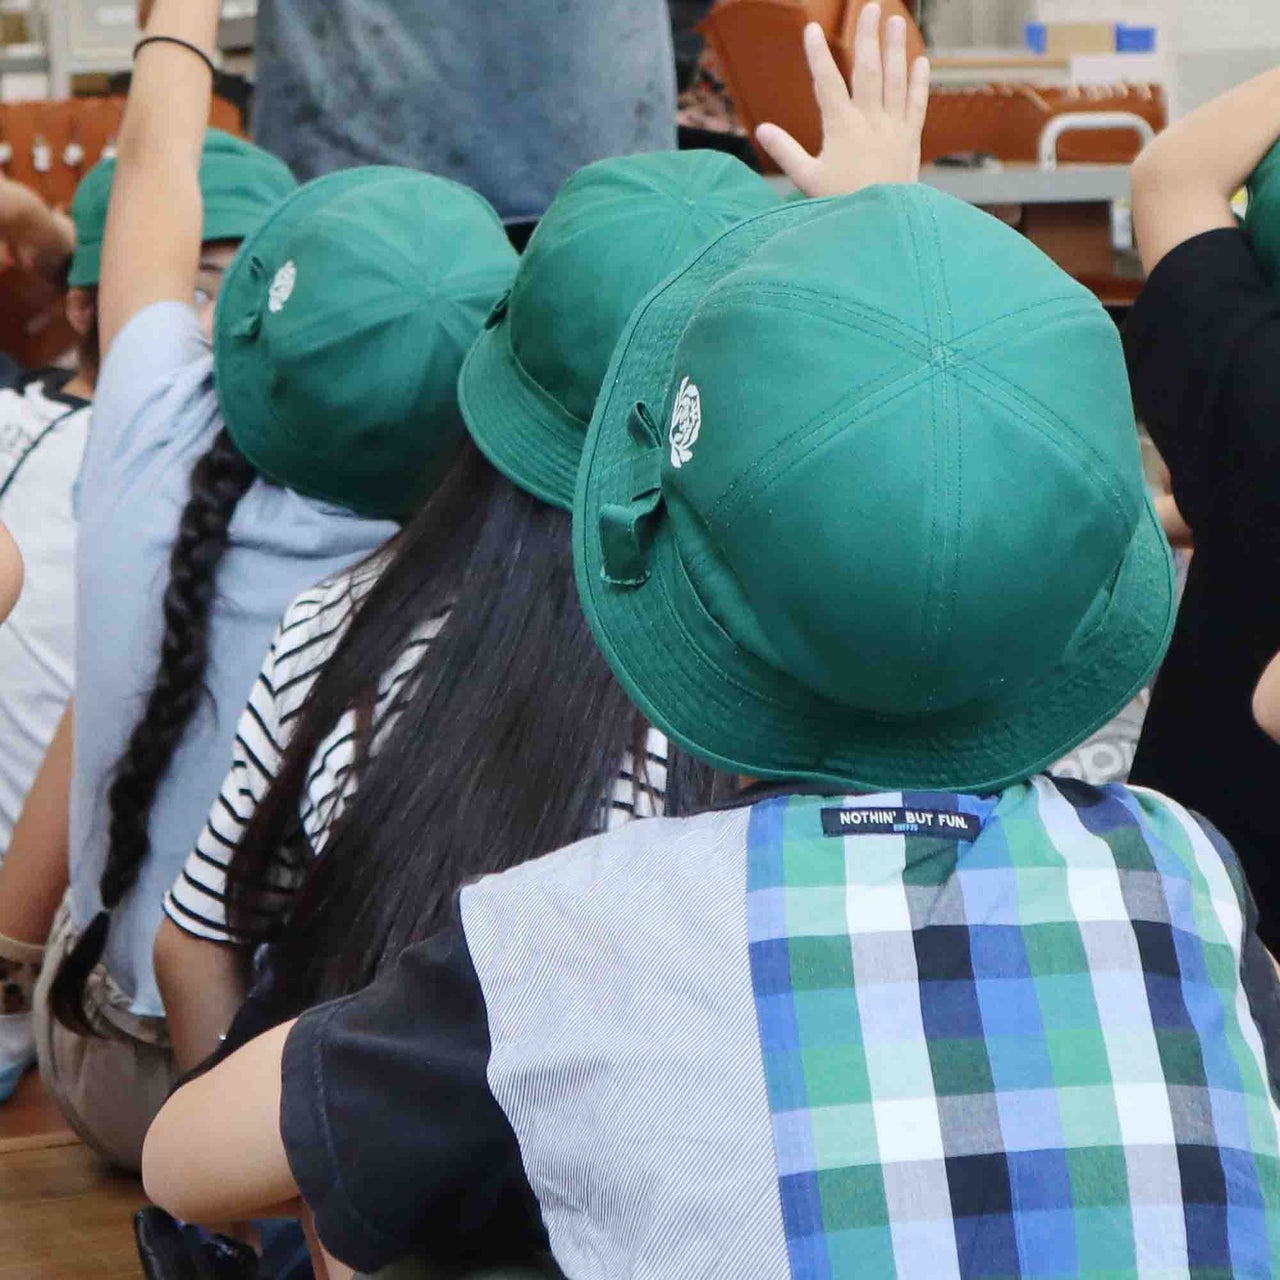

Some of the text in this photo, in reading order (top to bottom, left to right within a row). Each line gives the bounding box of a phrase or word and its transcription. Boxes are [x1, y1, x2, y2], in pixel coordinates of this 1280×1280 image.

[840, 811, 968, 829] NOTHIN' BUT FUN.
